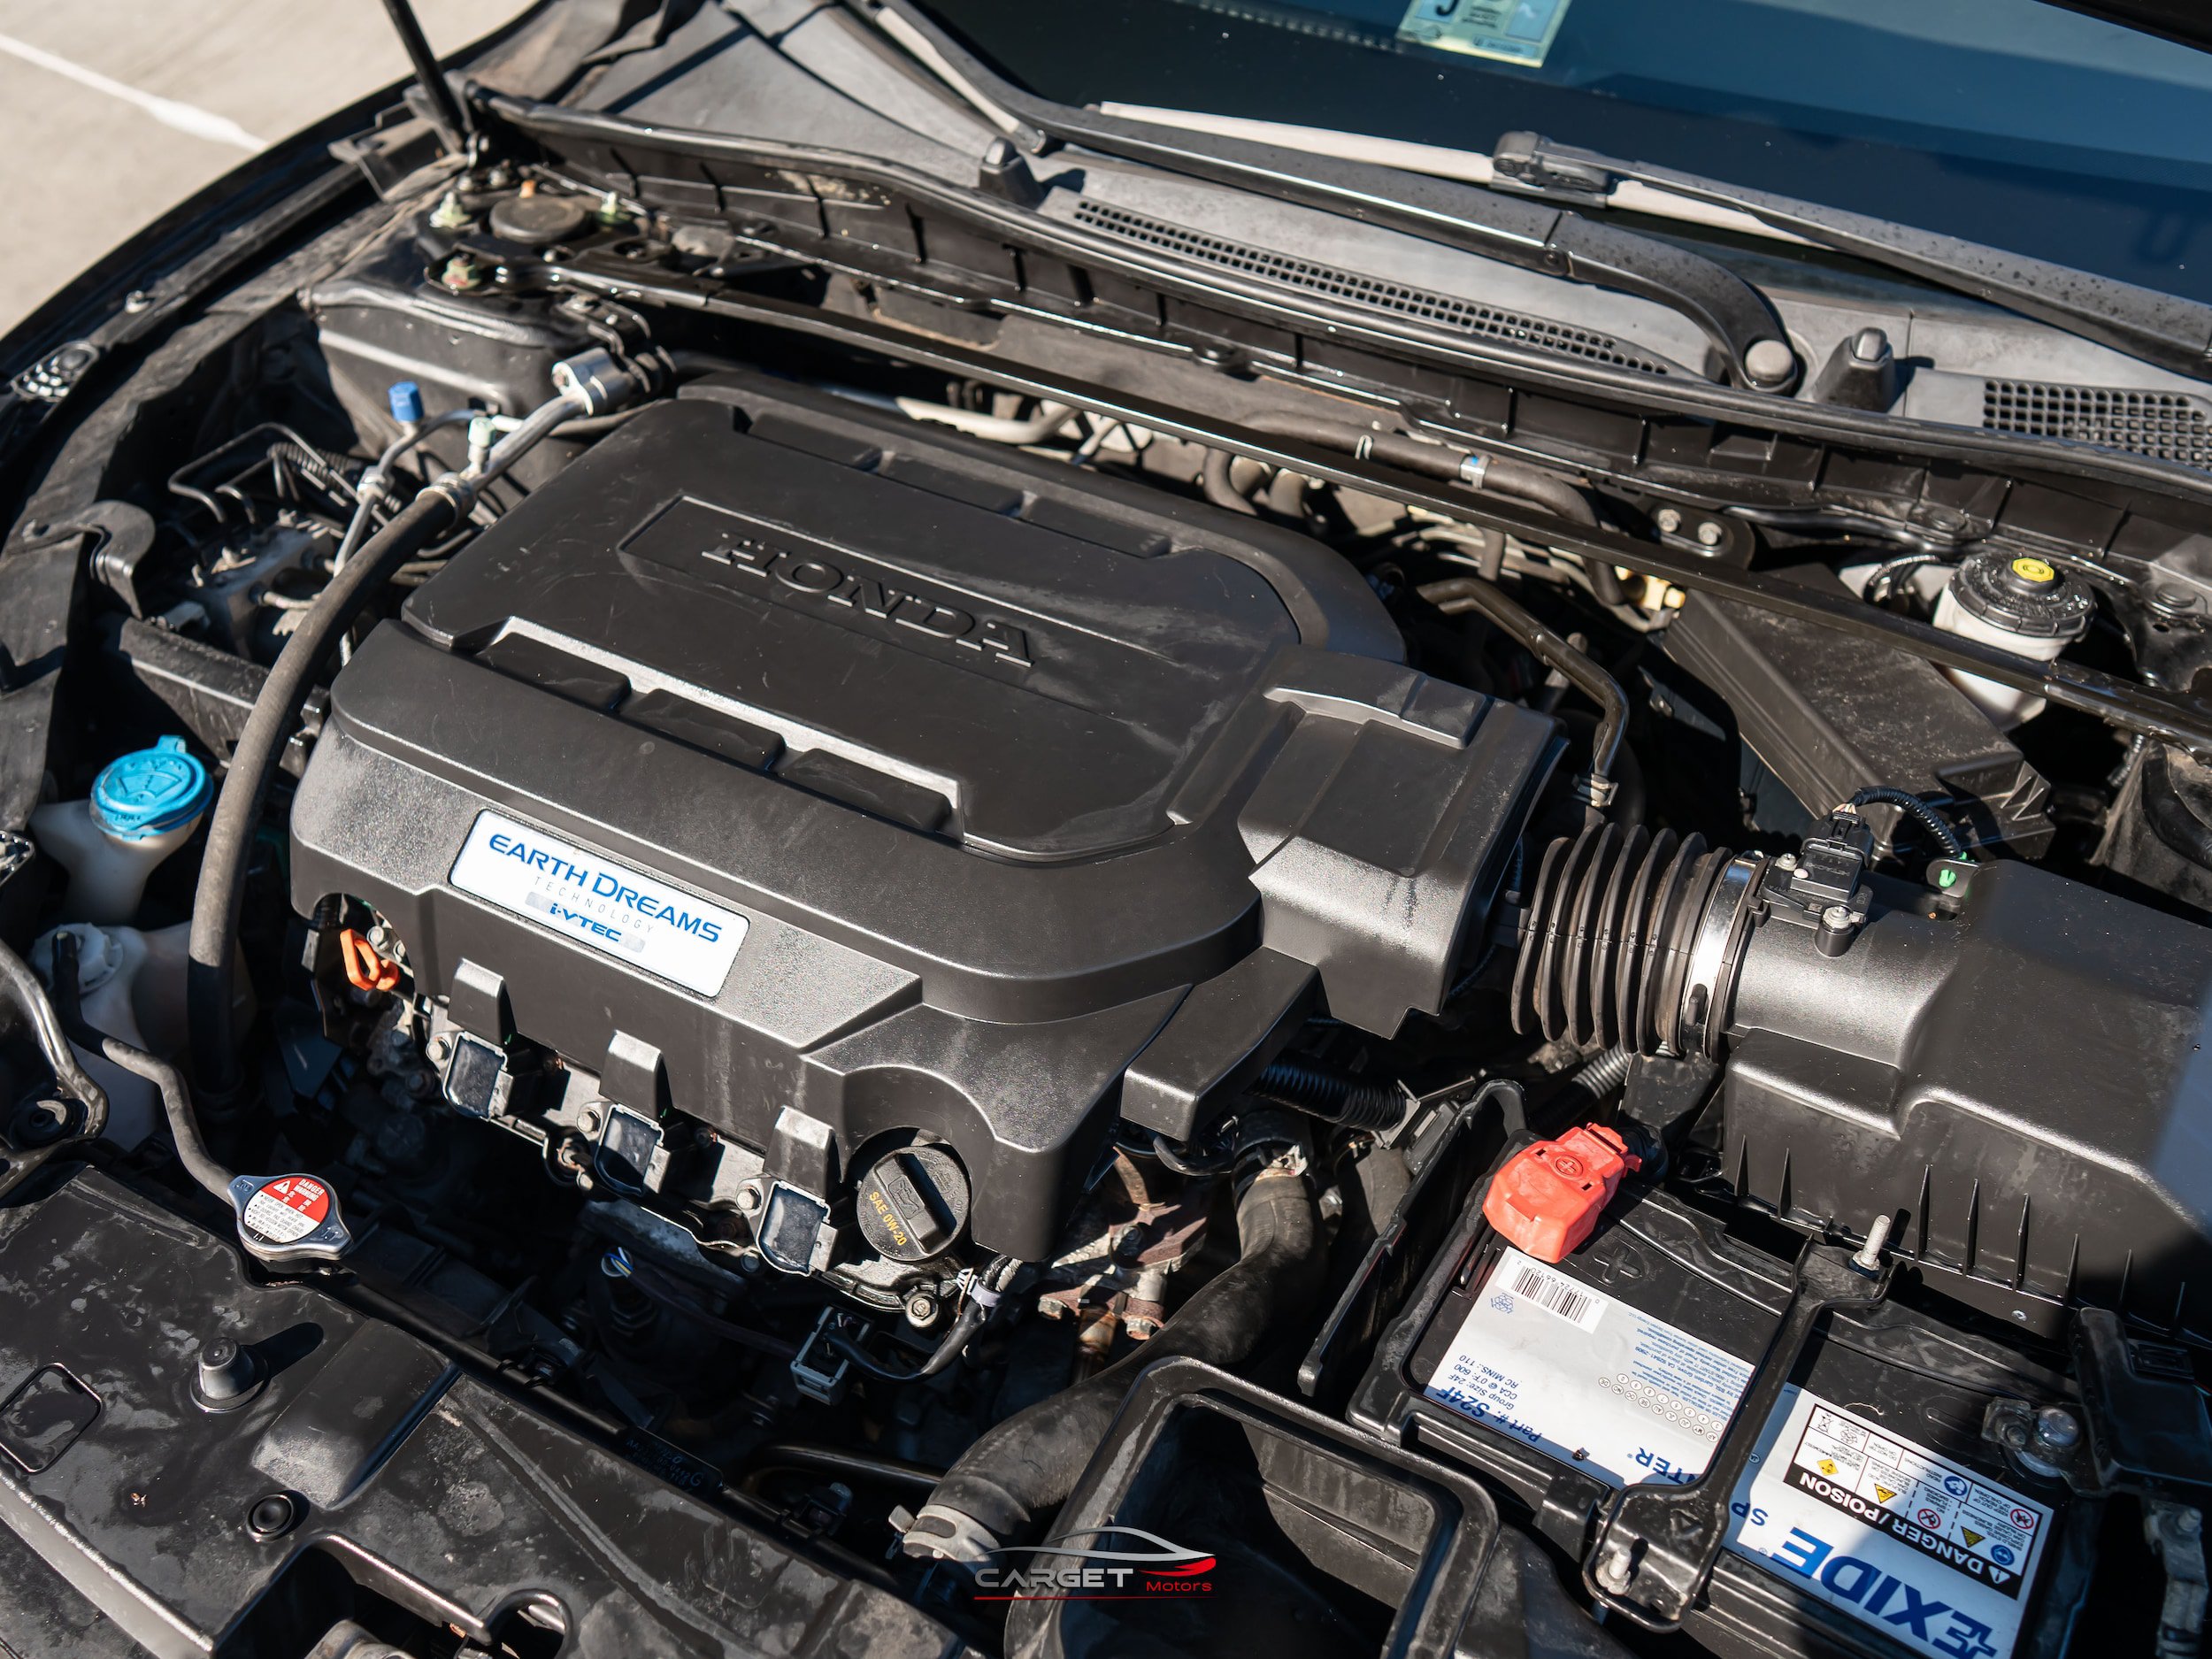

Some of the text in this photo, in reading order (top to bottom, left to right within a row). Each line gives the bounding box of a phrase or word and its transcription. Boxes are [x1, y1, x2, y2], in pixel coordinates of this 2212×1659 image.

[702, 532, 1035, 668] HONDA
[489, 833, 722, 943] EARTH DREAMS
[534, 876, 655, 933] TECHNOLOGY
[549, 902, 622, 942] i-VTEC
[298, 1179, 326, 1195] DANGER
[869, 1191, 888, 1215] SAE
[883, 1213, 908, 1247] 0W-20
[1530, 1265, 1556, 1284] 66120
[1559, 1280, 1583, 1297] 17724
[1459, 1355, 1474, 1365] 110
[1454, 1363, 1471, 1375] 600
[1448, 1374, 1514, 1409] Group Size: 24F
[1504, 1379, 1518, 1388] RC
[1499, 1386, 1517, 1399] CCA
[1434, 1386, 1489, 1422] S24F
[1507, 1419, 1541, 1445] Part
[1877, 1448, 1887, 1456] NOT
[1867, 1471, 1879, 1481] ACID
[1878, 1473, 1908, 1491] CAN CAUSE
[1880, 1469, 1909, 1486] BLINDNESS
[1890, 1469, 1910, 1483] SEVERE
[1925, 1472, 1940, 1482] READ
[1924, 1486, 1948, 1502] SMOKING
[1924, 1496, 1946, 1509] SPARKS
[1926, 1492, 1947, 1506] FLAMES
[1978, 1494, 2009, 1513] THE REACH
[1979, 1500, 1993, 1509] OUT
[1993, 1506, 2008, 1517] KEEP
[1961, 1508, 2024, 1543] CAN CAUSE BLINDNESS
[1892, 1518, 1983, 1573] DANGER
[1993, 1529, 2024, 1548] EXPLOSIVE
[2001, 1538, 2022, 1551] SHIELD
[1767, 1526, 2002, 1659] EXIDE
